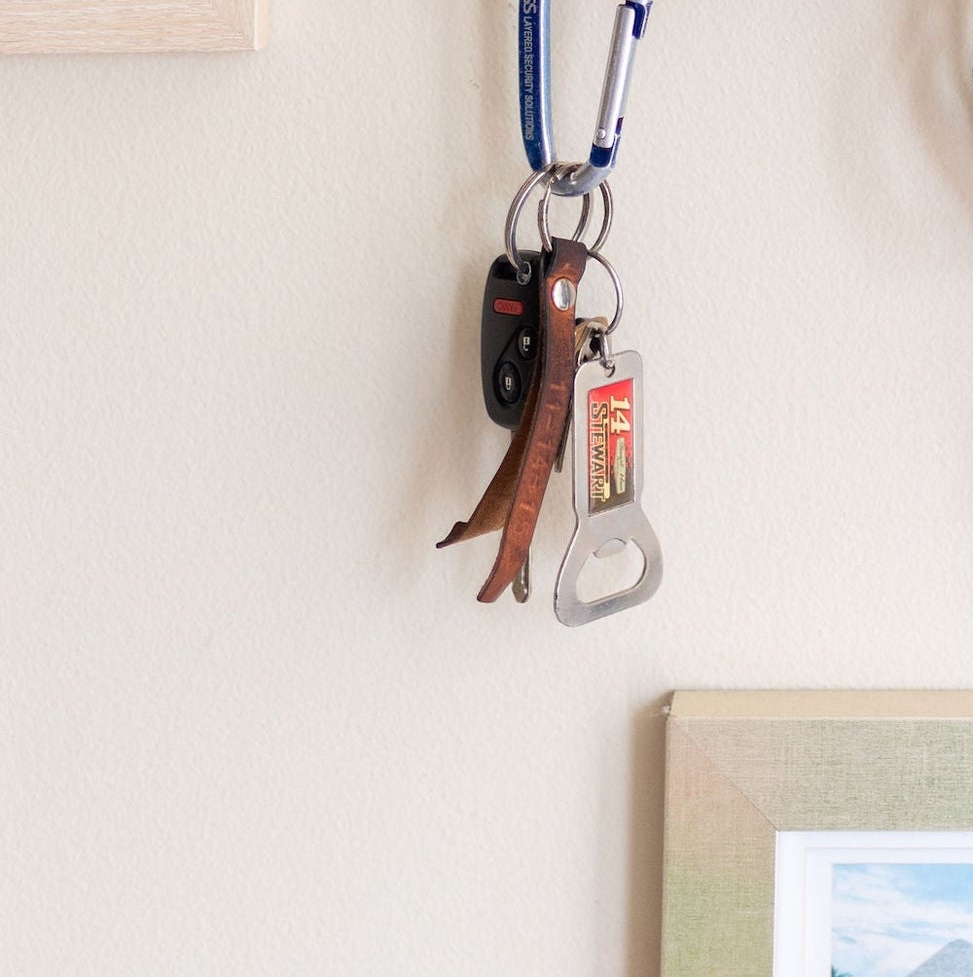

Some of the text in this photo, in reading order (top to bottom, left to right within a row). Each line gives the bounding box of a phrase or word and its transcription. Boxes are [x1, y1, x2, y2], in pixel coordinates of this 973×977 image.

[523, 16, 533, 53] LAYERED
[523, 53, 533, 93] SECURITY
[524, 94, 535, 141] SOLUTIONS
[610, 394, 631, 435] 14
[589, 401, 609, 503] STEWART
